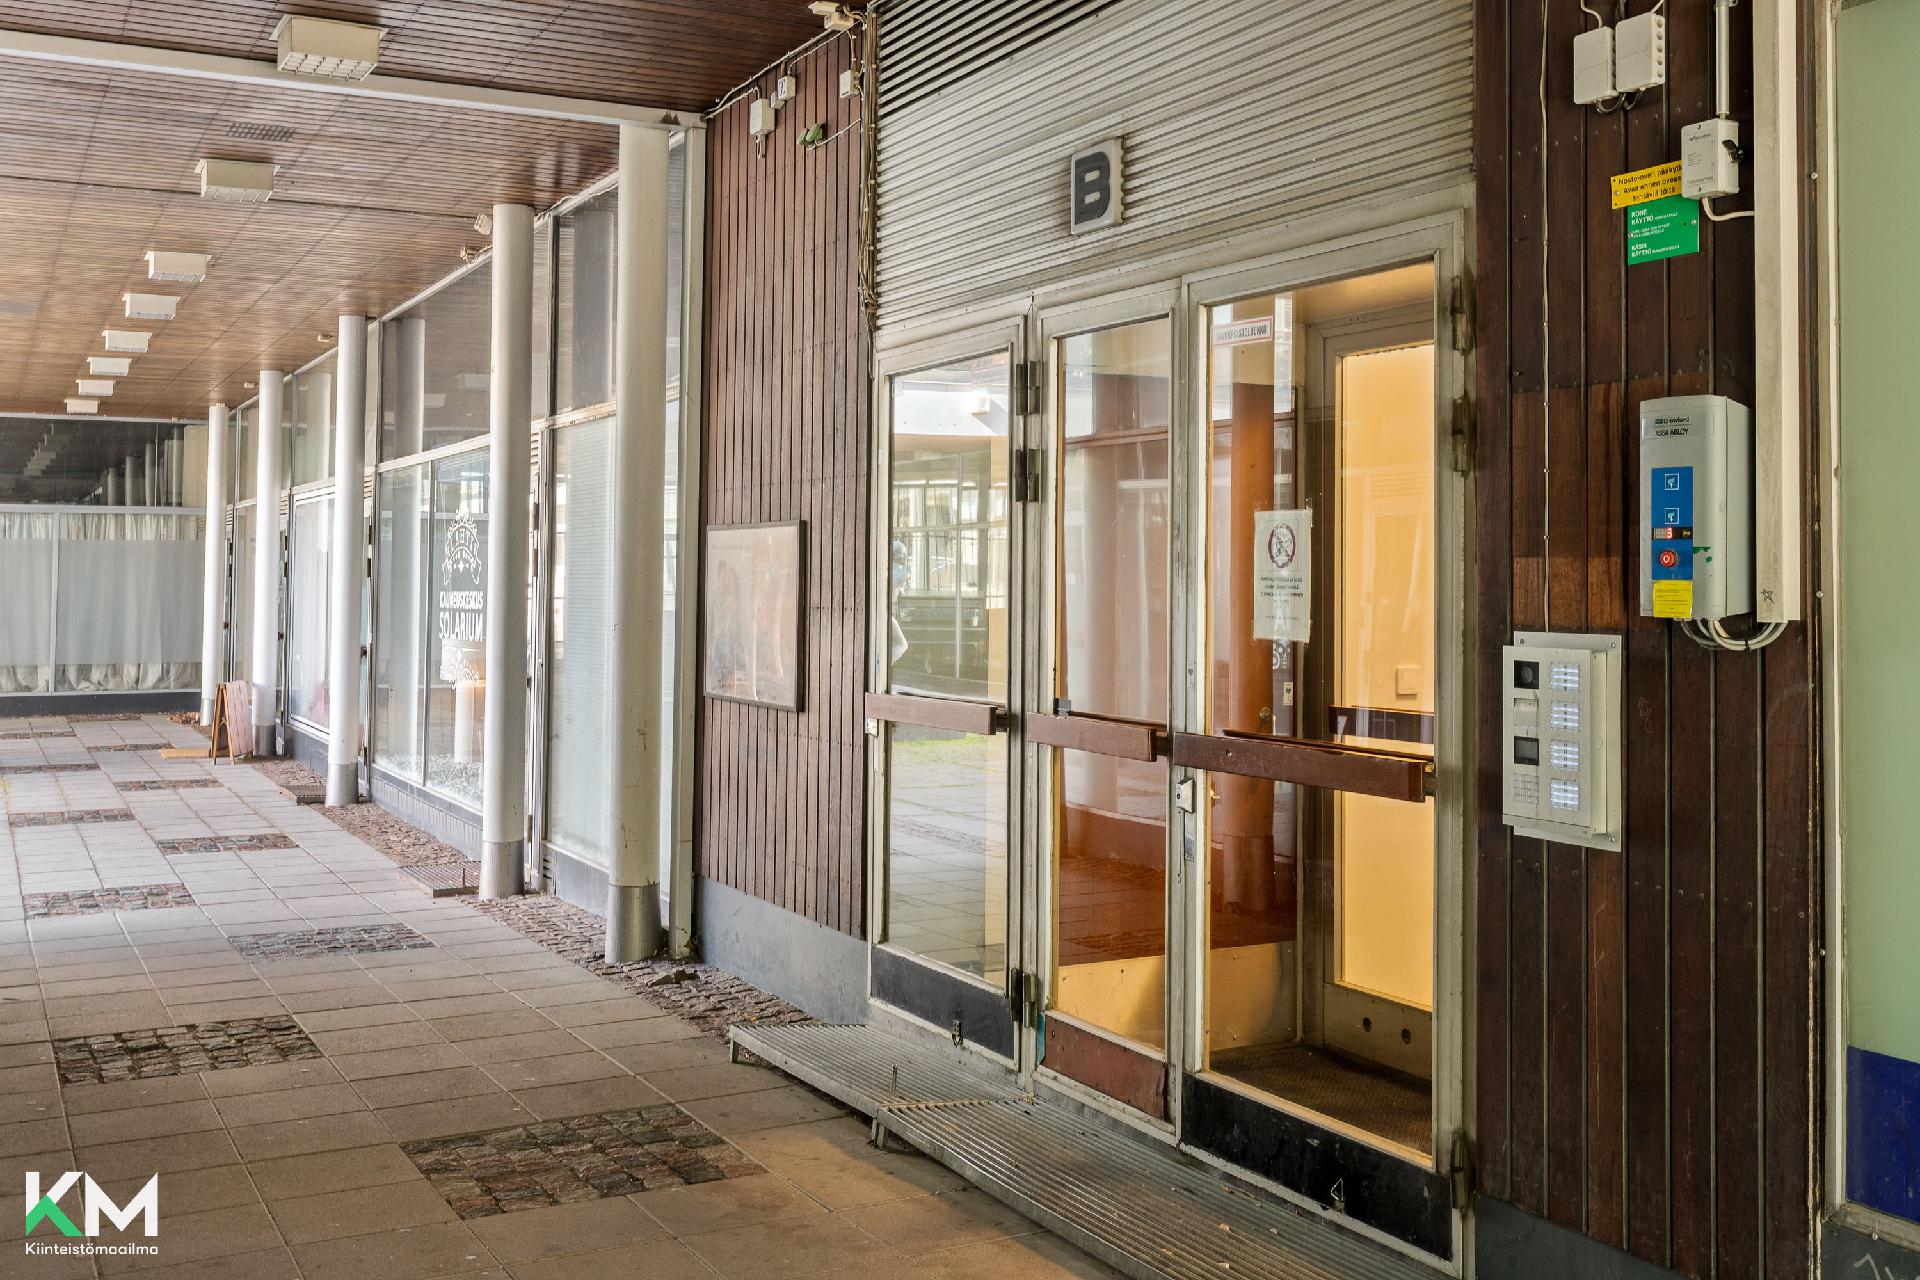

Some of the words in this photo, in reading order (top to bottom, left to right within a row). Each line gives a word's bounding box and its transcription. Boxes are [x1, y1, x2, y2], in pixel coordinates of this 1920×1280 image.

[1618, 171, 1656, 185] Nosto-oven
[1074, 151, 1111, 226] B
[1623, 185, 1639, 194] Avaa
[1640, 180, 1661, 191] ennen
[1631, 208, 1648, 218] KONE
[1631, 214, 1654, 226] KÄYTTÖ
[1631, 248, 1652, 258] KÄYTTÖ
[1655, 429, 1669, 437] ASSA
[1669, 428, 1689, 436] ABLOY
[439, 611, 484, 642] SOLARIUM
